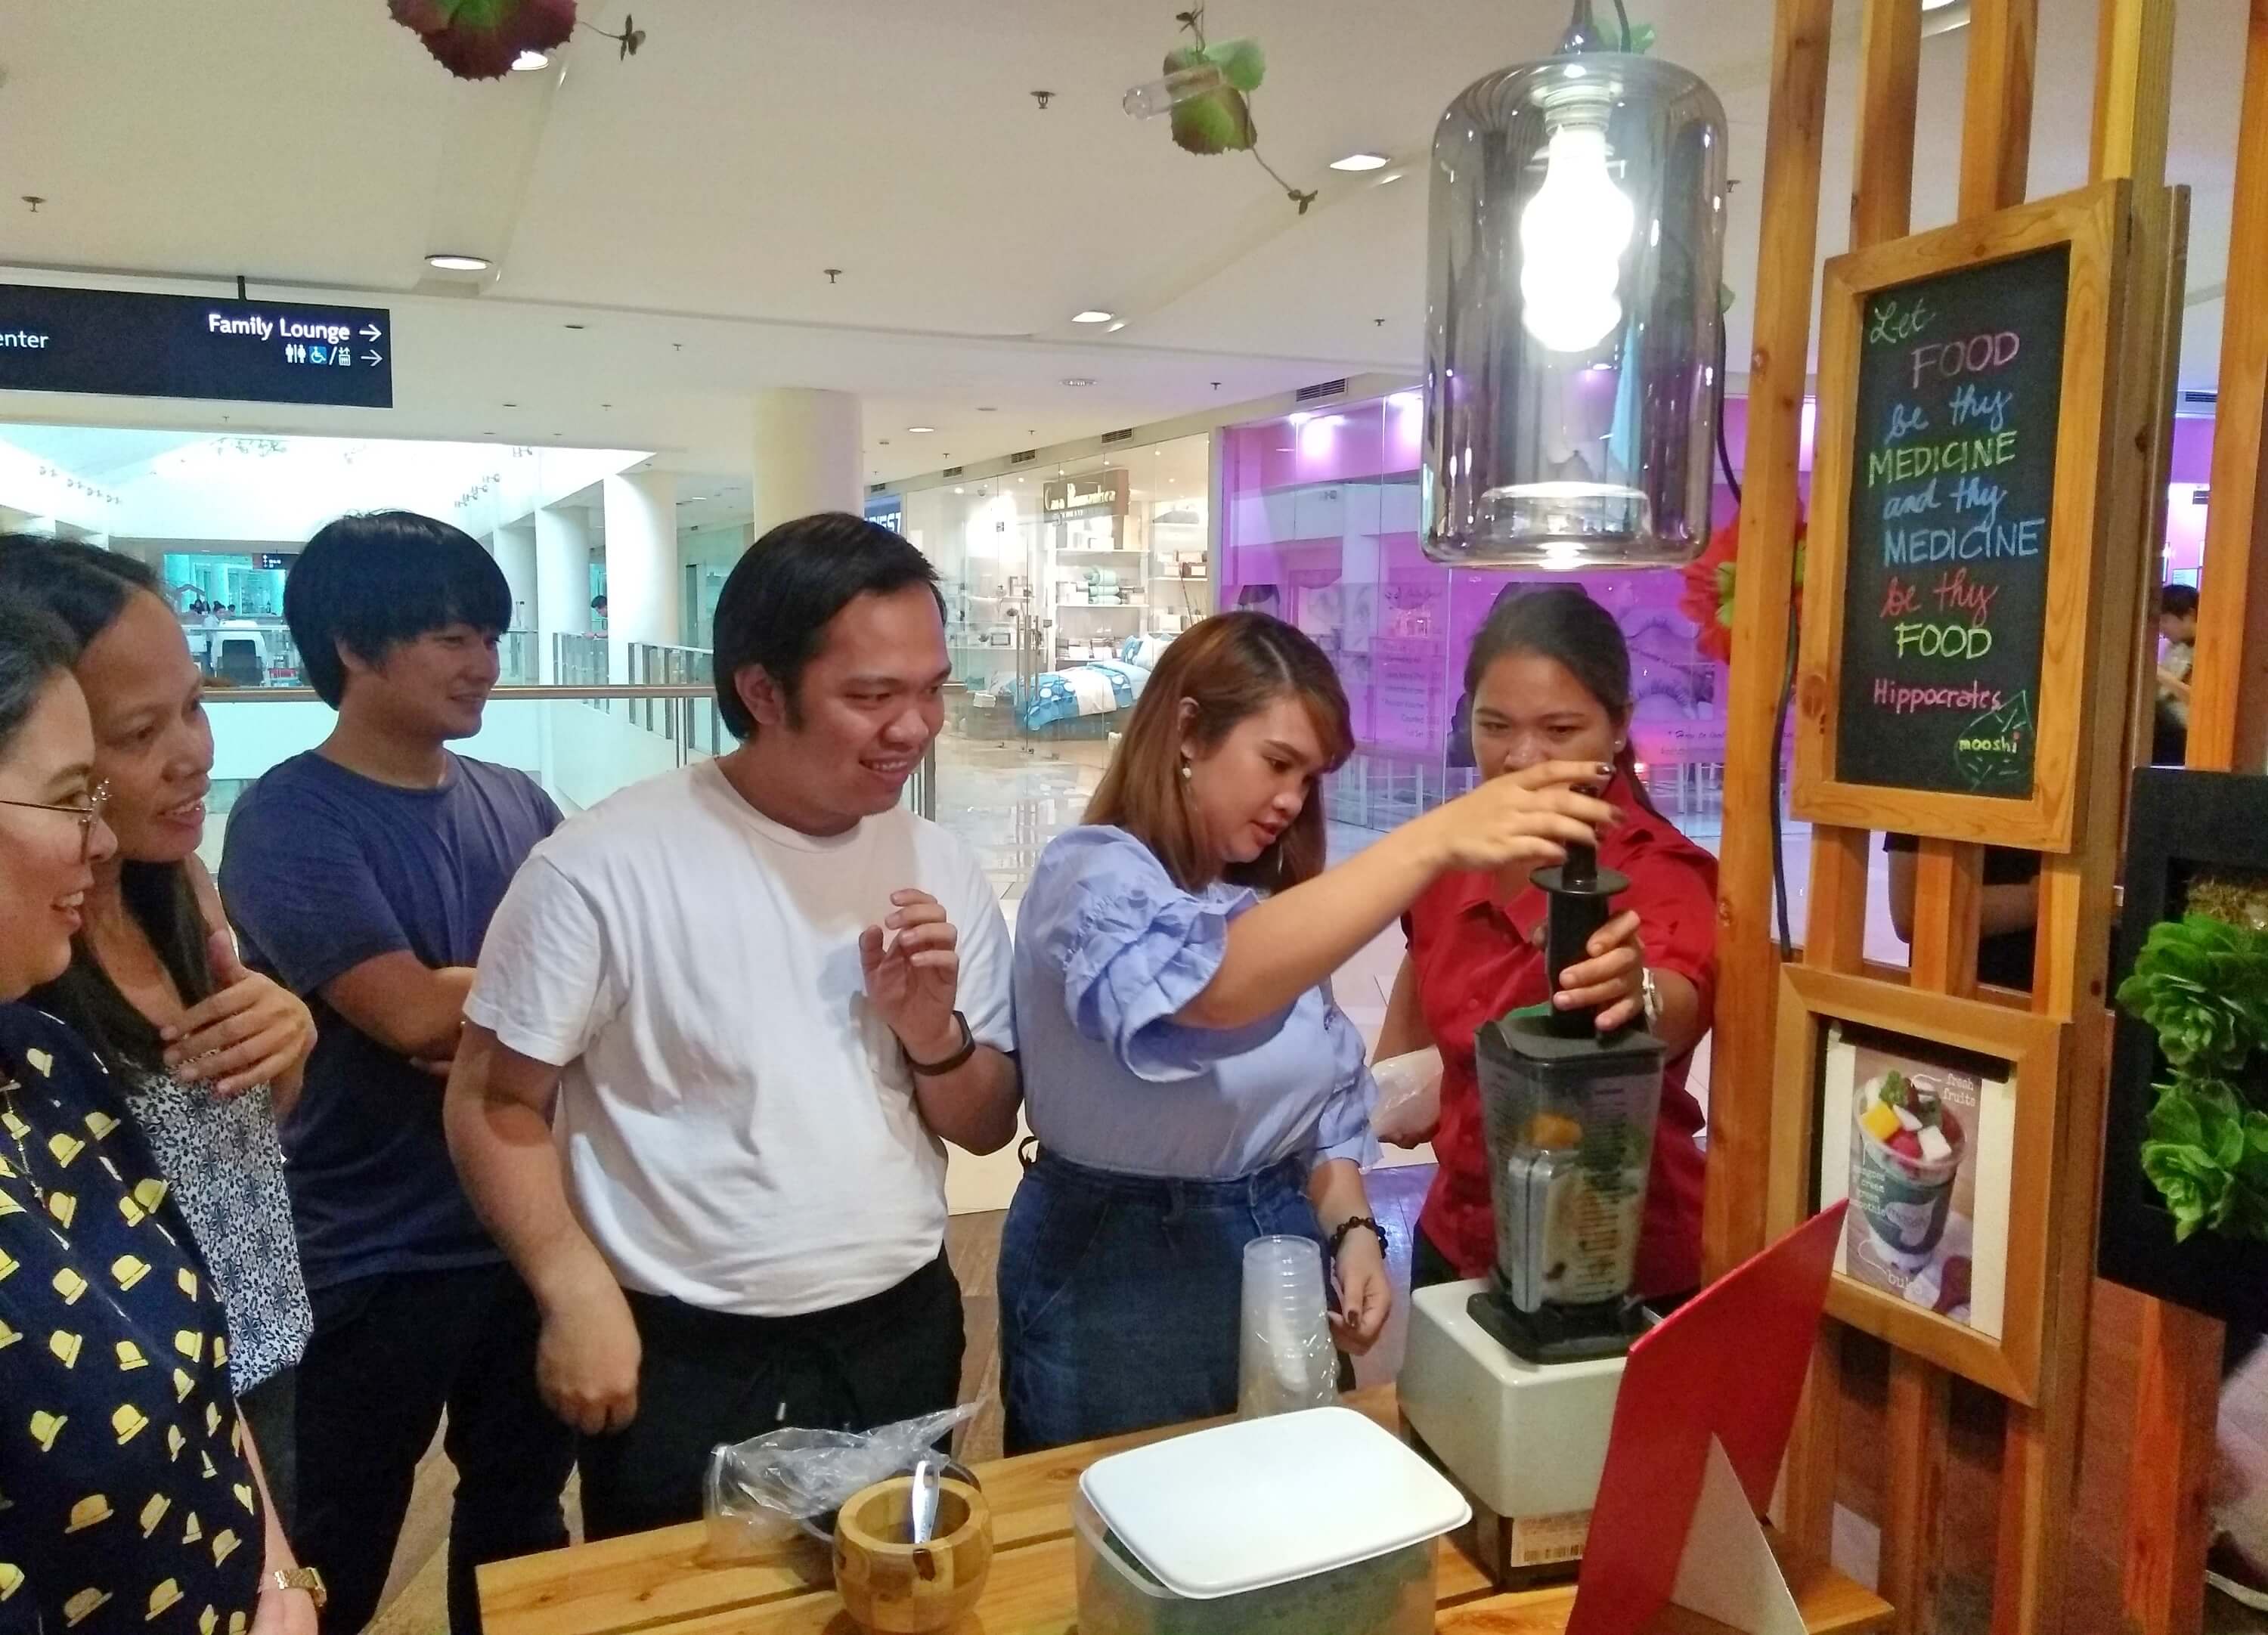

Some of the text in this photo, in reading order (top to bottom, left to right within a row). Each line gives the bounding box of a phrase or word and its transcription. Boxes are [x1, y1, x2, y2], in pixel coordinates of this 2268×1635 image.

[208, 314, 351, 345] Family Lounge
[1870, 298, 1935, 344] Let
[1910, 332, 2020, 389] FOOD
[1884, 383, 2012, 444] be thy
[1868, 431, 2018, 488] MEDICINE
[1882, 476, 2008, 531] and thy
[1884, 518, 2045, 566] MEDICINE
[1879, 567, 1998, 628] be thy
[1894, 622, 1992, 659] FOOD
[1873, 677, 2003, 714] Hippocrates
[1959, 731, 2019, 753] mooshi
[1942, 1087, 1975, 1107] fruits
